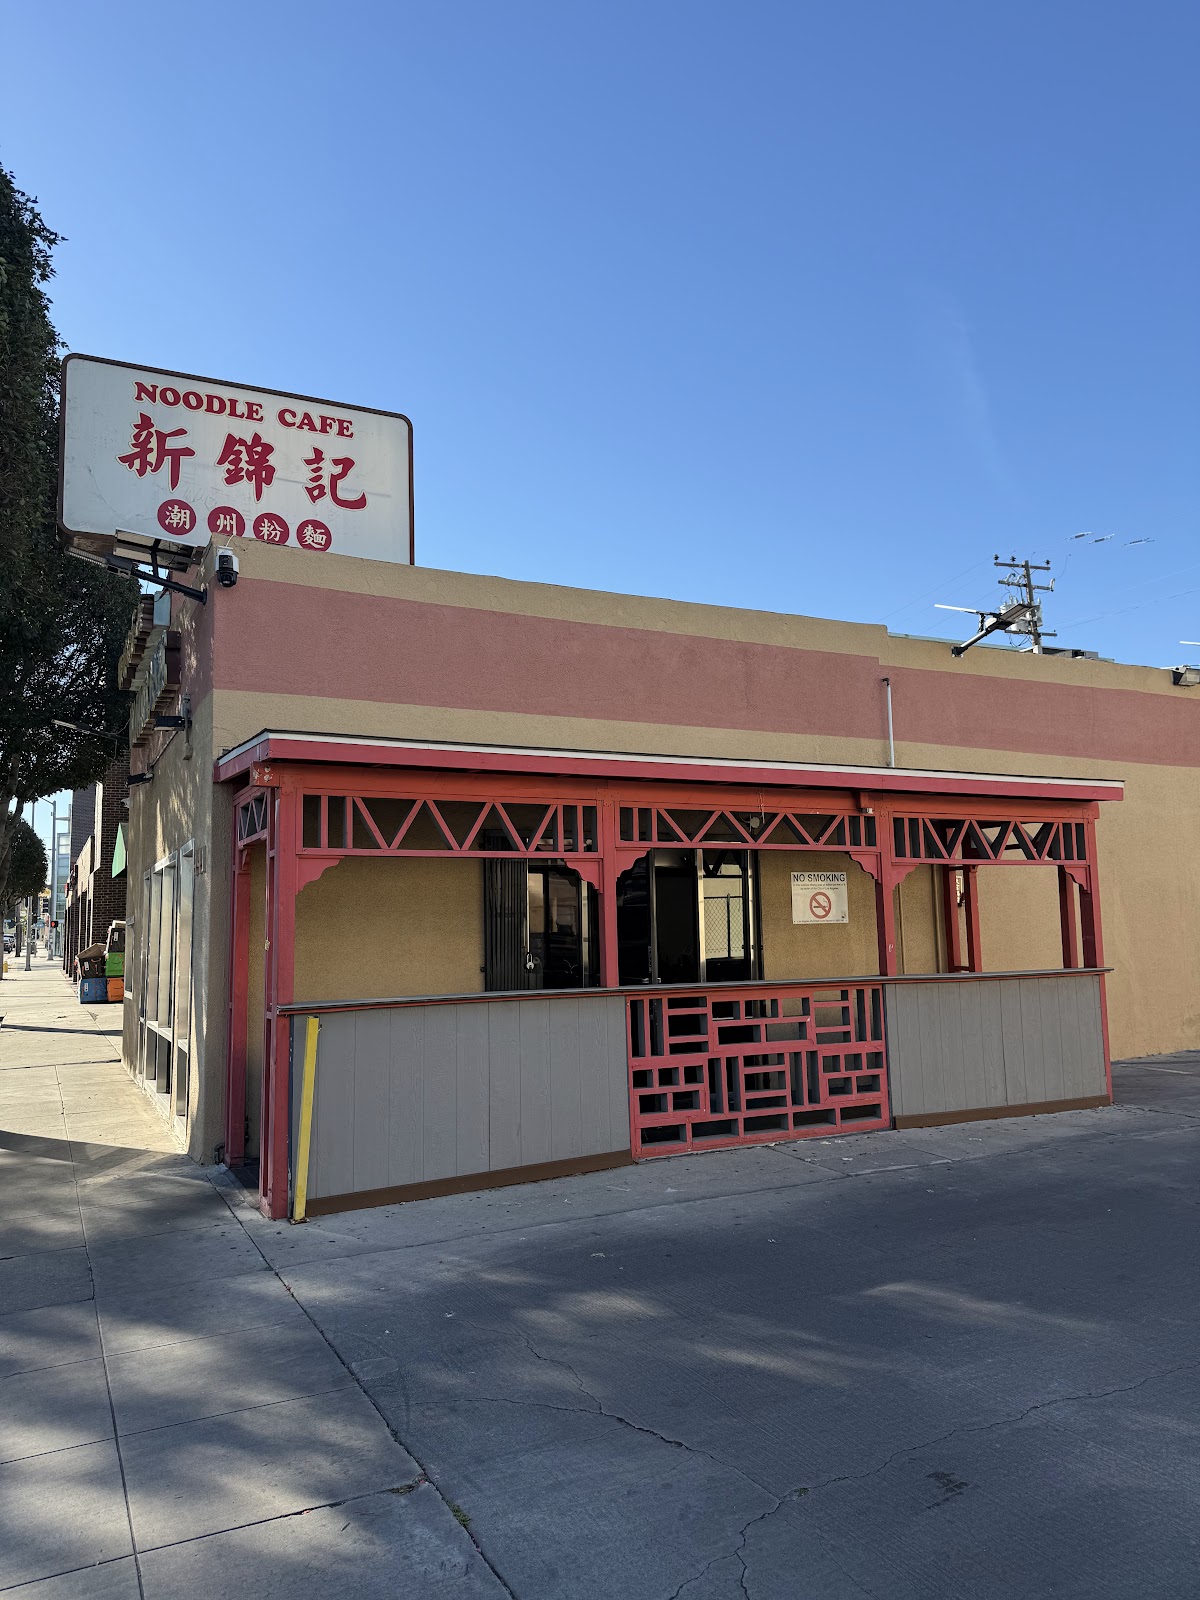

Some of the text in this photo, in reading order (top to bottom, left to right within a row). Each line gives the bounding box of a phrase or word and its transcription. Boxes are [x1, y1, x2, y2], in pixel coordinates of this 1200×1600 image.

[135, 381, 354, 439] NOODLE CAFE
[118, 412, 367, 511] 新錦記
[164, 503, 328, 550] 潮州粉麵
[793, 873, 845, 882] NO SMOKING
